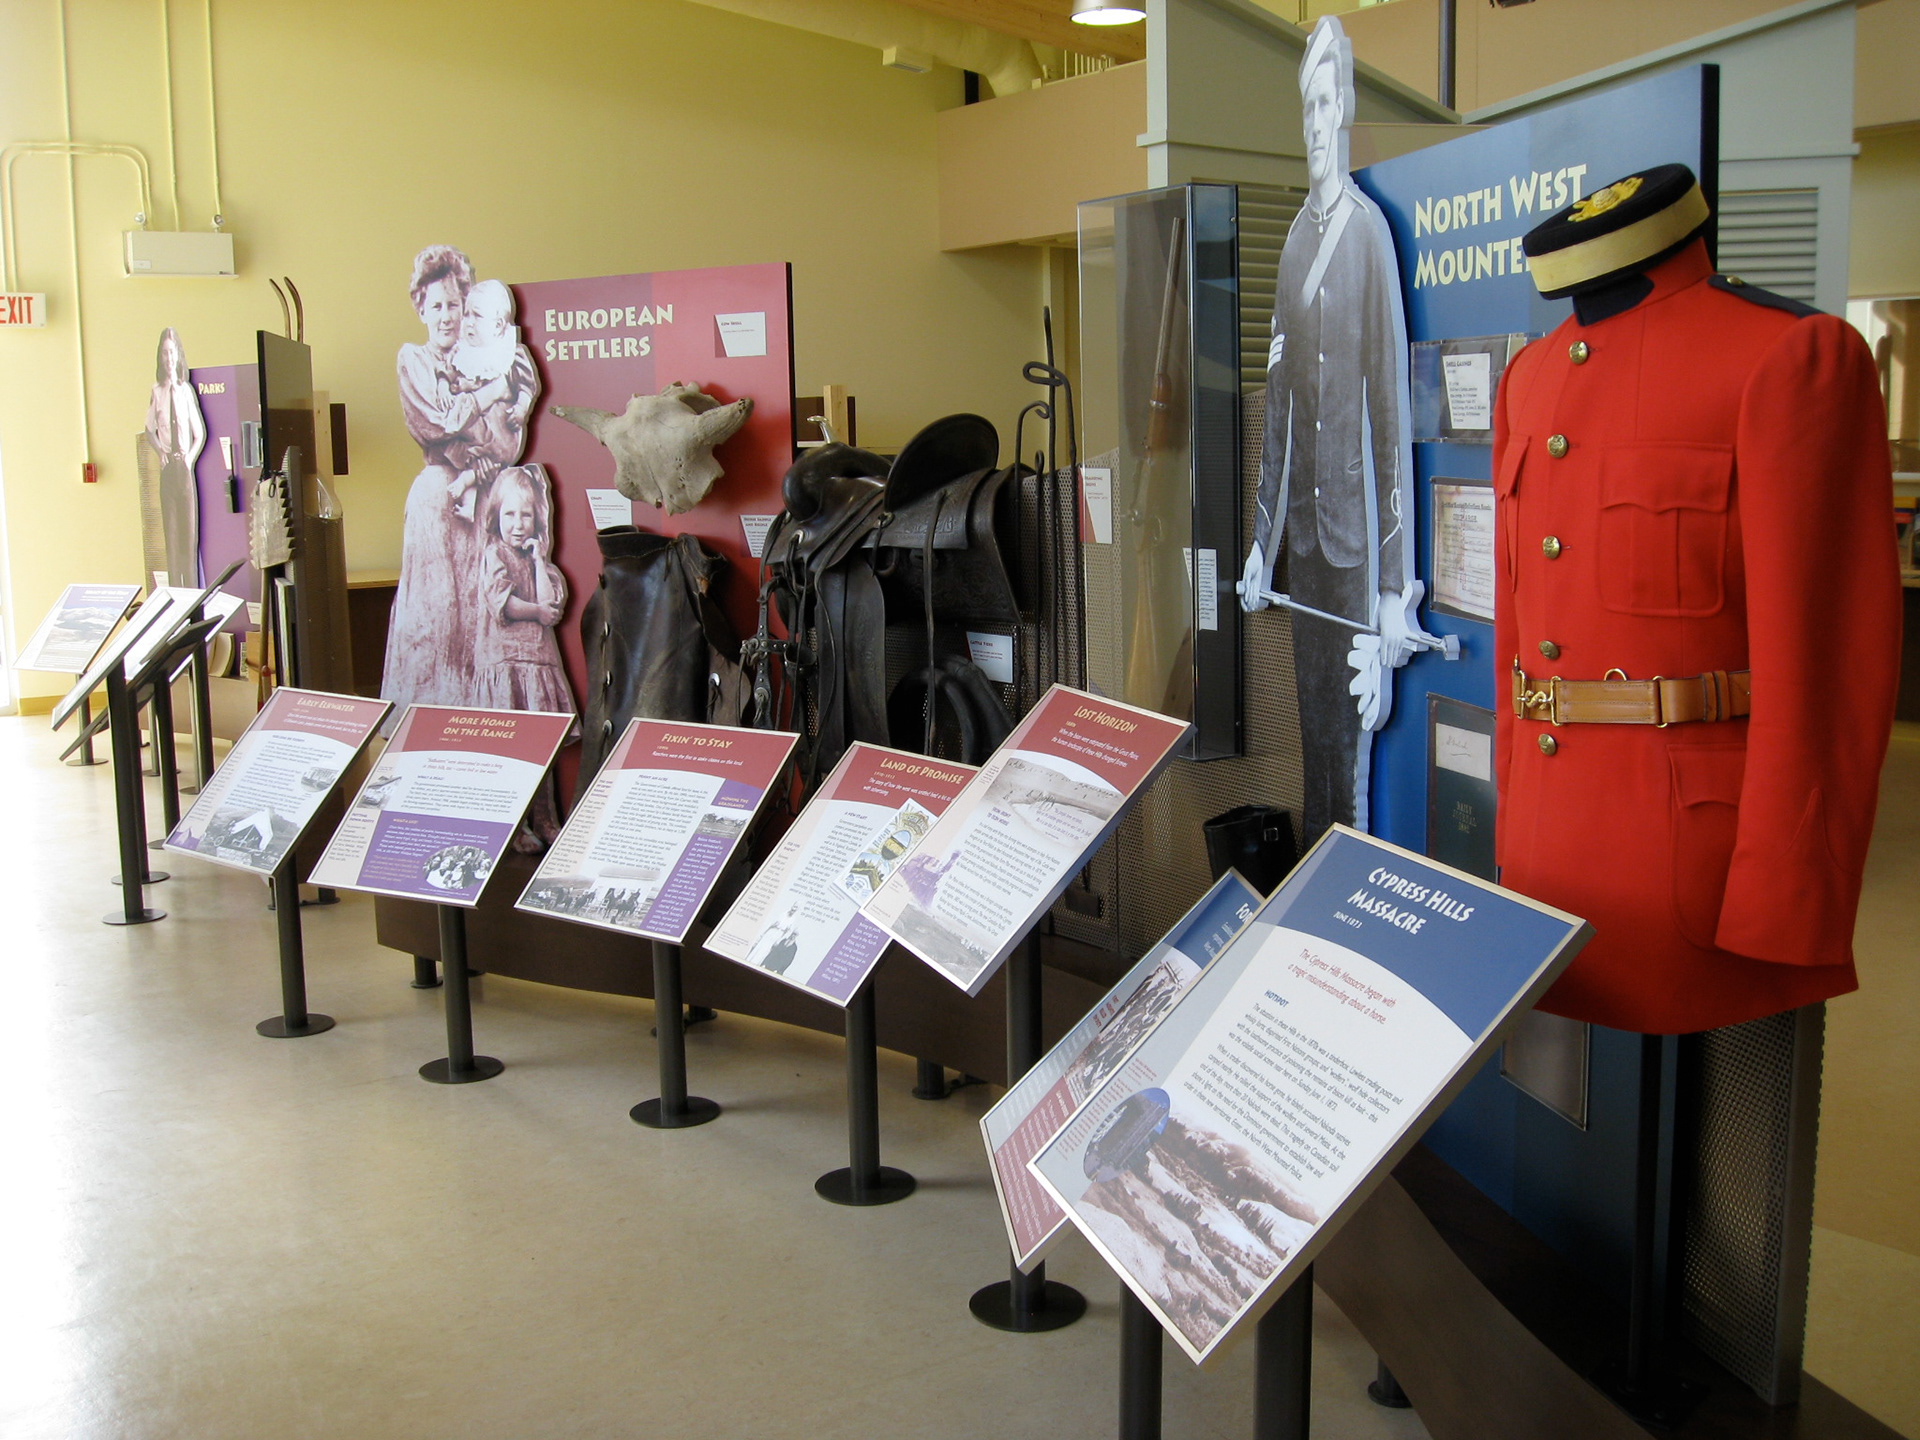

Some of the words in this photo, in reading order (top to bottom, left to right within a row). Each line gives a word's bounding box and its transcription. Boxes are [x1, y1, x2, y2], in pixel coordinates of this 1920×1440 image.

[1415, 184, 1502, 239] NORTH
[1509, 163, 1587, 219] WEST
[1413, 236, 1530, 290] MOUNTE
[545, 304, 673, 332] EUROPEAN
[545, 336, 652, 362] SETTLERS
[443, 727, 460, 735] ON
[460, 728, 480, 737] THE
[480, 728, 516, 739] RANGE
[448, 716, 480, 726] MORE
[479, 717, 517, 728] HOMES
[1073, 705, 1098, 721] LOST
[1093, 712, 1138, 733] HORIZON
[692, 737, 707, 746] TO
[707, 738, 734, 749] STAY
[880, 758, 907, 771] LAND
[906, 765, 922, 775] OF
[920, 766, 965, 785] PROMISE
[1369, 867, 1430, 902] CYPRESS
[1425, 890, 1474, 922] HILLS
[1333, 911, 1350, 922] JUNE
[1346, 917, 1363, 929] 1873
[1348, 889, 1426, 934] MASSACRE
[1291, 965, 1309, 979] tragic
[1306, 974, 1350, 1005] misunderstanding
[1347, 998, 1367, 1012] about
[1363, 1007, 1372, 1015] a
[1299, 948, 1311, 961] The
[1309, 954, 1330, 971] Cypress
[1327, 965, 1342, 978] Hills
[1339, 972, 1366, 992] Massacre
[1363, 985, 1384, 1001] began
[1381, 997, 1397, 1008] with
[1264, 990, 1290, 1008] HOTSPOT
